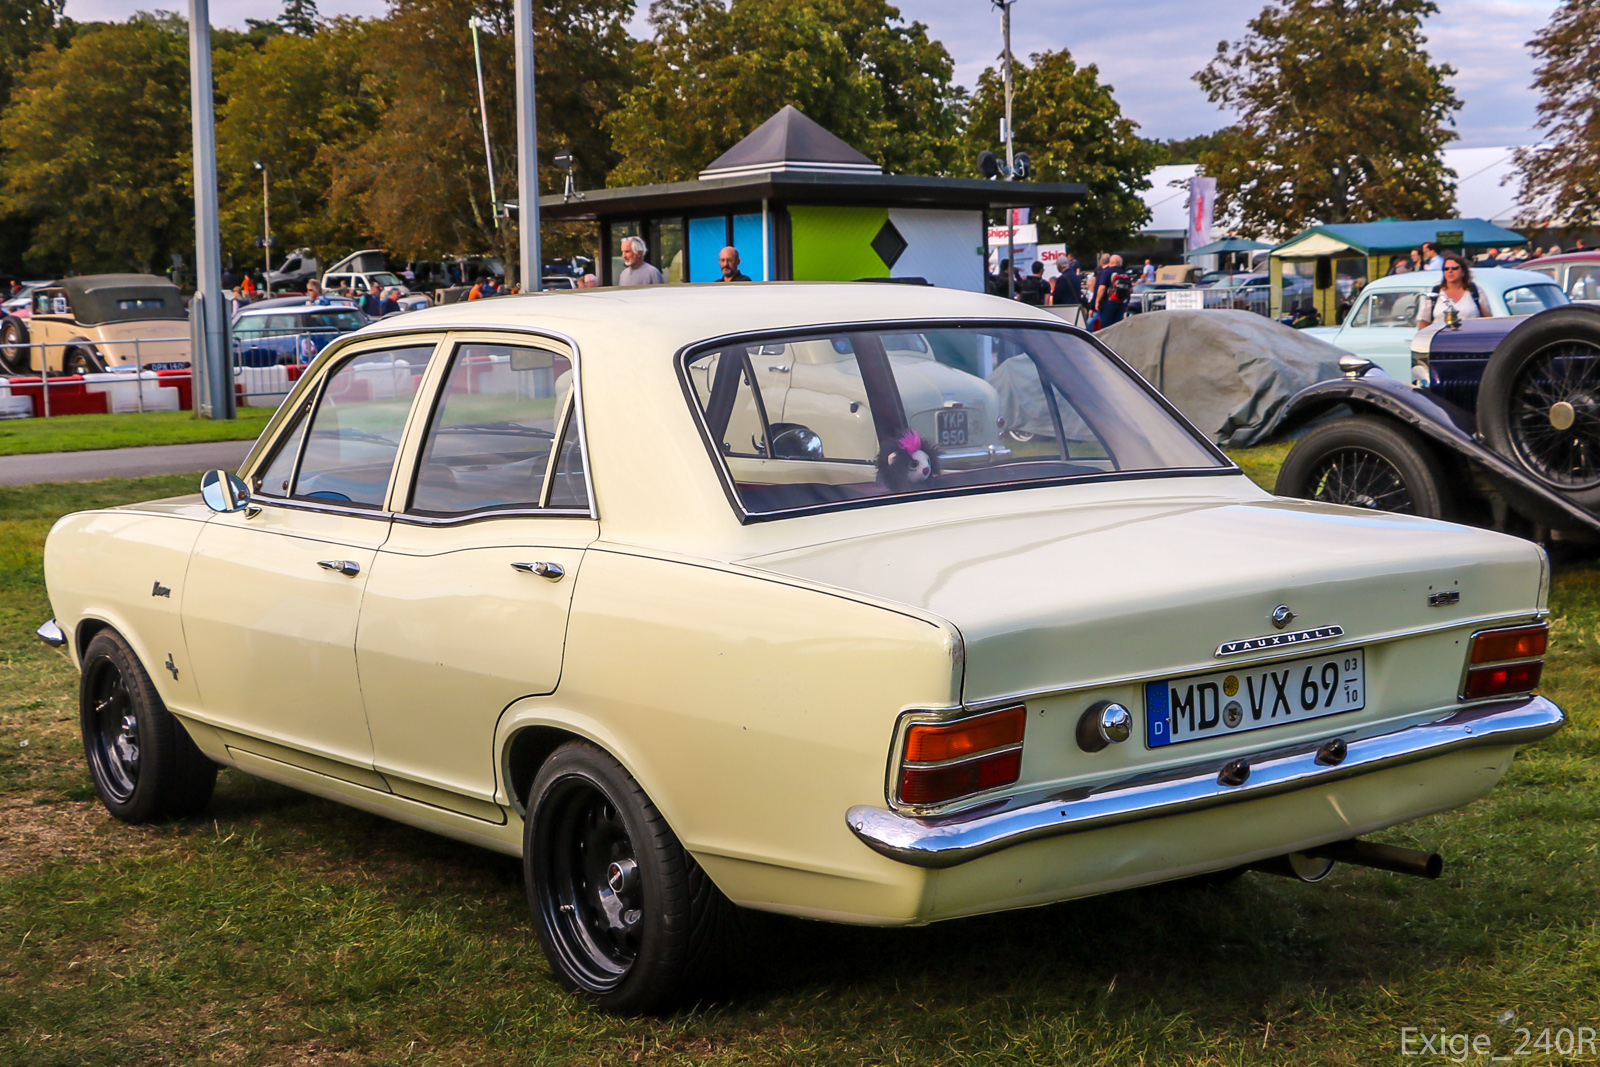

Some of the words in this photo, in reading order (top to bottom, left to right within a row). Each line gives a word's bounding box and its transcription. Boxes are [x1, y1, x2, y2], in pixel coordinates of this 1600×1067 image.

[942, 412, 965, 428] YKP
[942, 430, 965, 445] 950
[1228, 629, 1335, 651] VAUXHALL
[1344, 658, 1358, 671] 03
[1154, 721, 1163, 735] D
[1170, 682, 1220, 734] MD
[1246, 669, 1291, 720] VX
[1300, 661, 1339, 711] 69
[1345, 689, 1358, 703] 10
